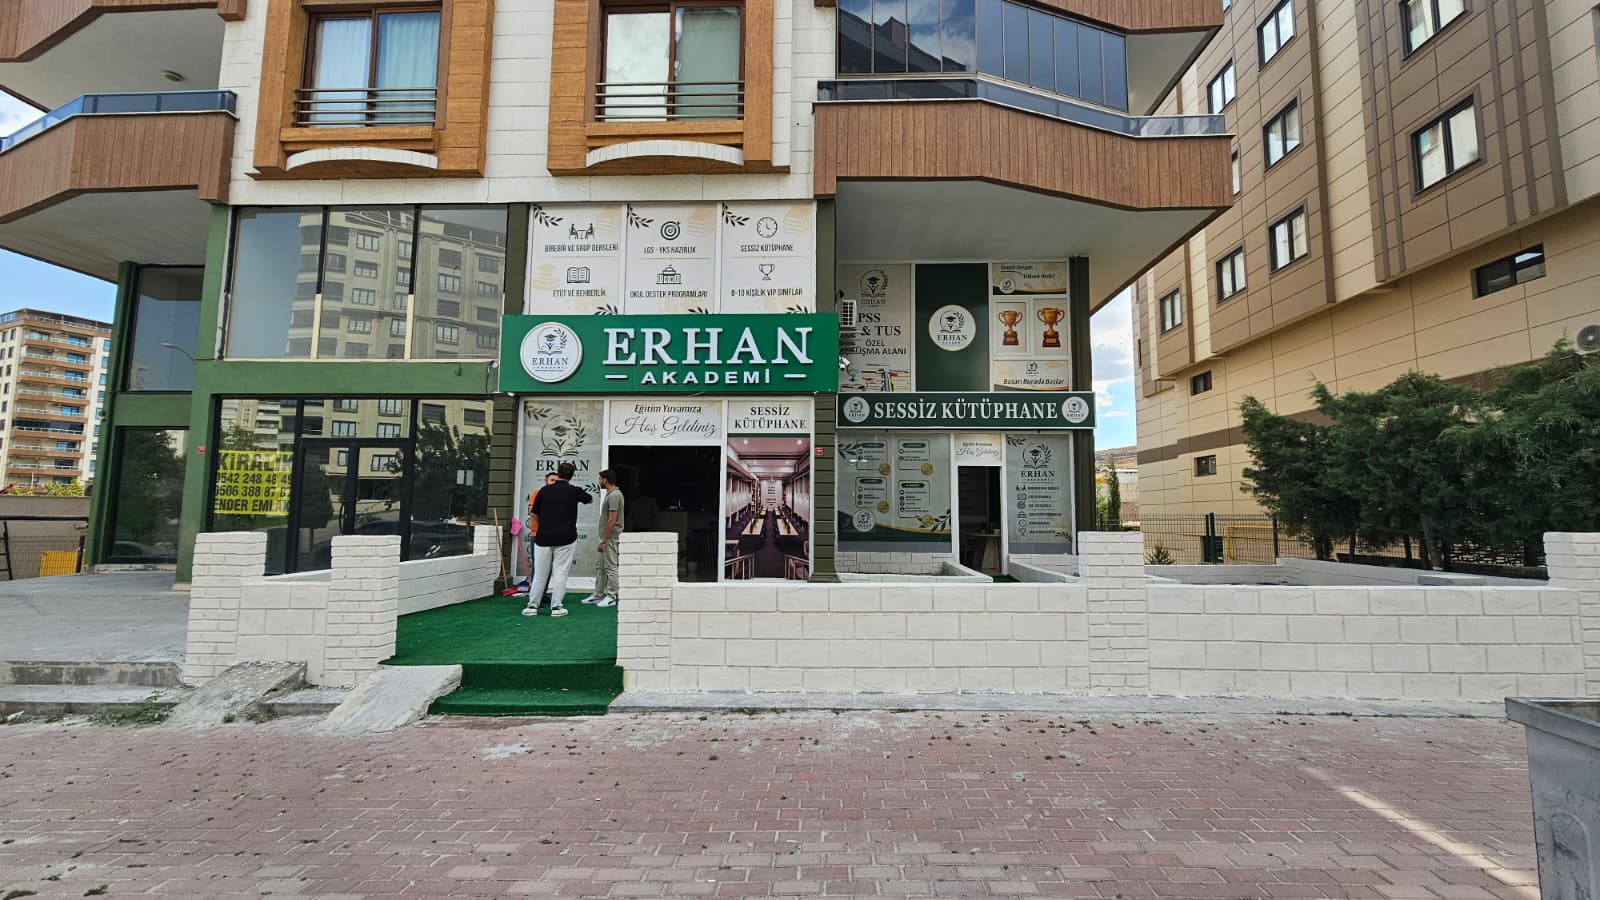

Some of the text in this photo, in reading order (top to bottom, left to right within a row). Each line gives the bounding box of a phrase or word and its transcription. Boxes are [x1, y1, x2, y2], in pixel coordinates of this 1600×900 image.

[568, 244, 575, 252] VE
[575, 244, 591, 252] GRUP
[644, 246, 655, 254] LGS
[659, 246, 670, 254] YKS
[671, 246, 696, 254] HAZIRLIK
[568, 289, 575, 297] VE
[630, 290, 644, 298] OKUL
[645, 290, 667, 298] DESTEK
[856, 312, 881, 323] PSS
[861, 325, 901, 336] & TUS
[602, 327, 813, 365] ERHAN
[865, 338, 885, 347] ÖZEL
[882, 347, 907, 355] ALANI
[532, 357, 569, 366] ERHAN
[641, 368, 770, 384] AKADEMİ
[634, 404, 702, 414] Eğitim Yuvamıza
[750, 404, 790, 416] SESSİZ
[874, 398, 1058, 419] SESSİZ KÜTÜPHANE
[660, 415, 720, 438] Geldiniz
[734, 417, 807, 429] KÜTÜPHANE
[242, 473, 262, 485] 248
[265, 474, 277, 485] 48
[1020, 470, 1055, 478] ERHAN
[241, 486, 261, 497] 388
[264, 486, 276, 497] 87
[213, 498, 249, 512] ENDER
